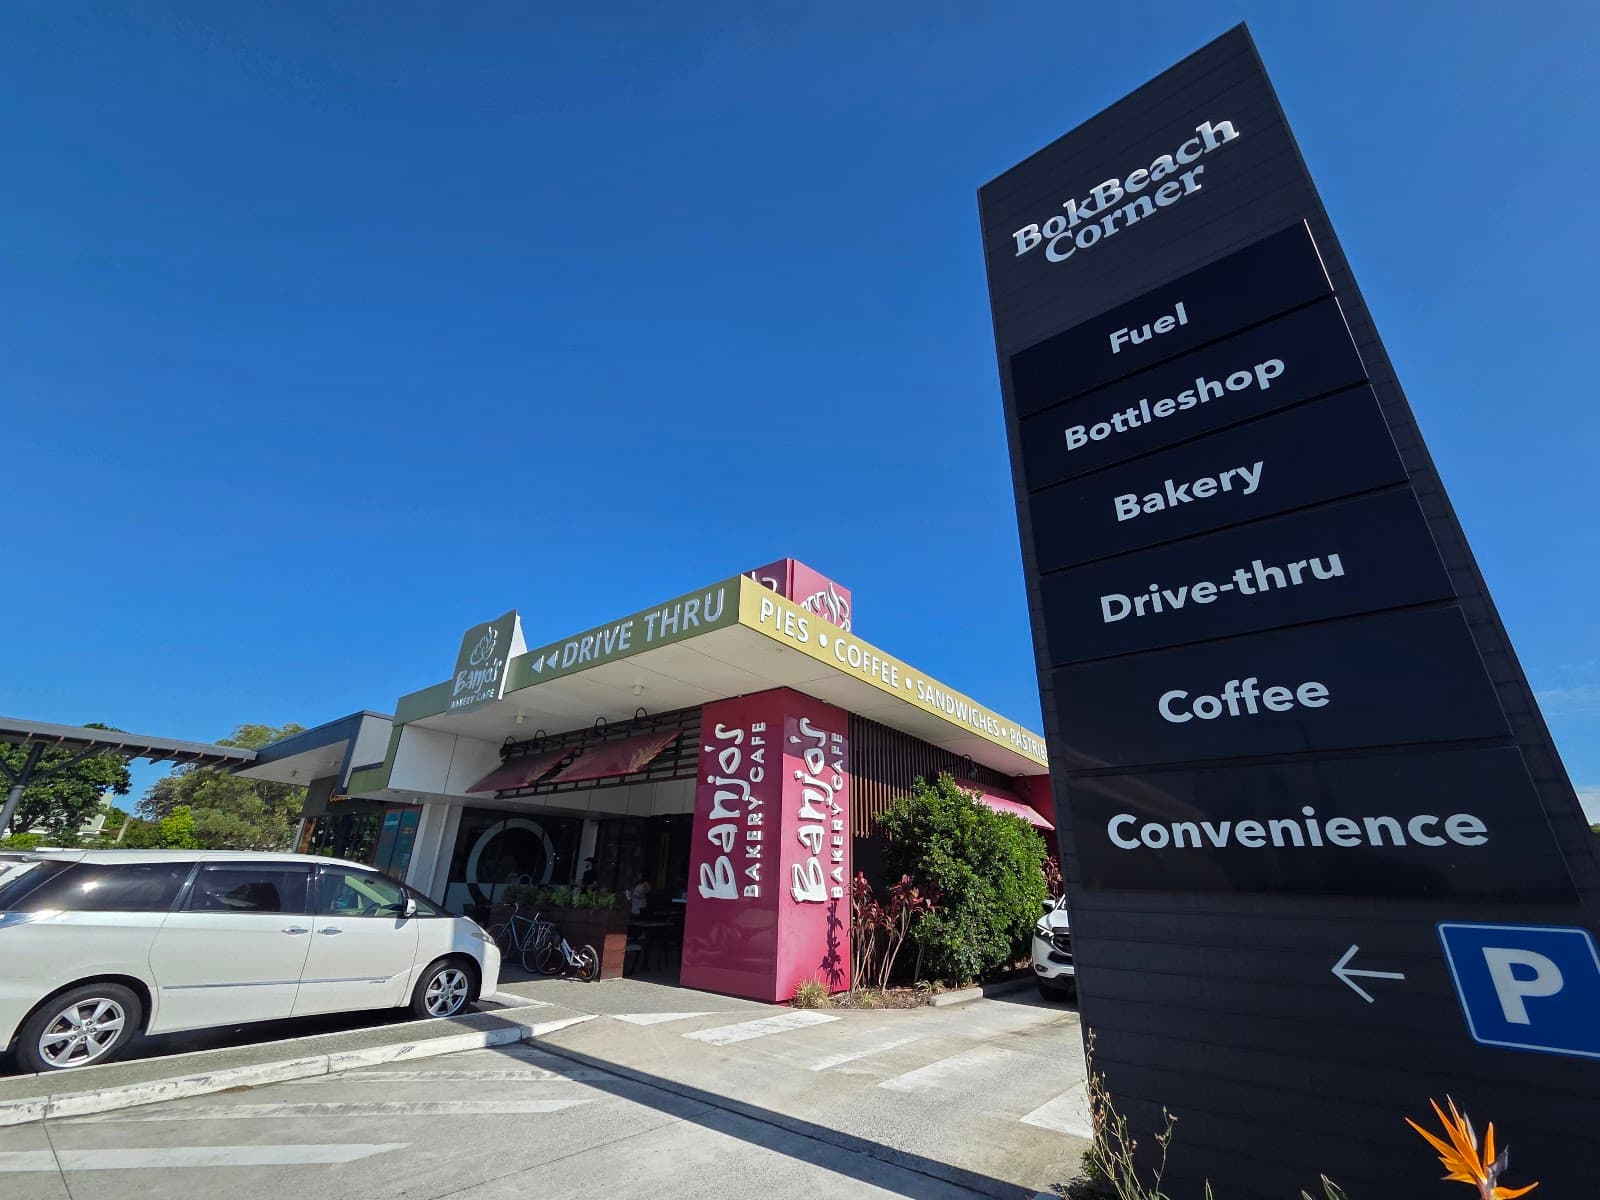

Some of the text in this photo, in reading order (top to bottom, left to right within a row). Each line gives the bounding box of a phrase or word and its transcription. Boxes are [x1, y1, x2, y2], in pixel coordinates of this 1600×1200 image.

[1012, 120, 1240, 256] BokBeach
[1045, 164, 1204, 263] Corner
[1109, 302, 1189, 354] Fuel
[1064, 358, 1286, 451] Bottleshop
[1114, 460, 1264, 522] Bakery
[562, 587, 725, 669] DRIVE THRU
[1100, 553, 1345, 624] Drive-thru
[759, 597, 809, 644] PIES
[834, 638, 899, 689] COFFEE
[916, 680, 1000, 737] SANDWICHES
[1158, 677, 1331, 723] Coffee
[698, 723, 751, 900] Banjo's
[743, 721, 766, 898] BAKERY CAFE
[790, 717, 834, 902] Banjo's
[831, 732, 843, 898] BAKERY CAFE
[1107, 805, 1490, 850] Convenience
[1481, 946, 1564, 1025] P
